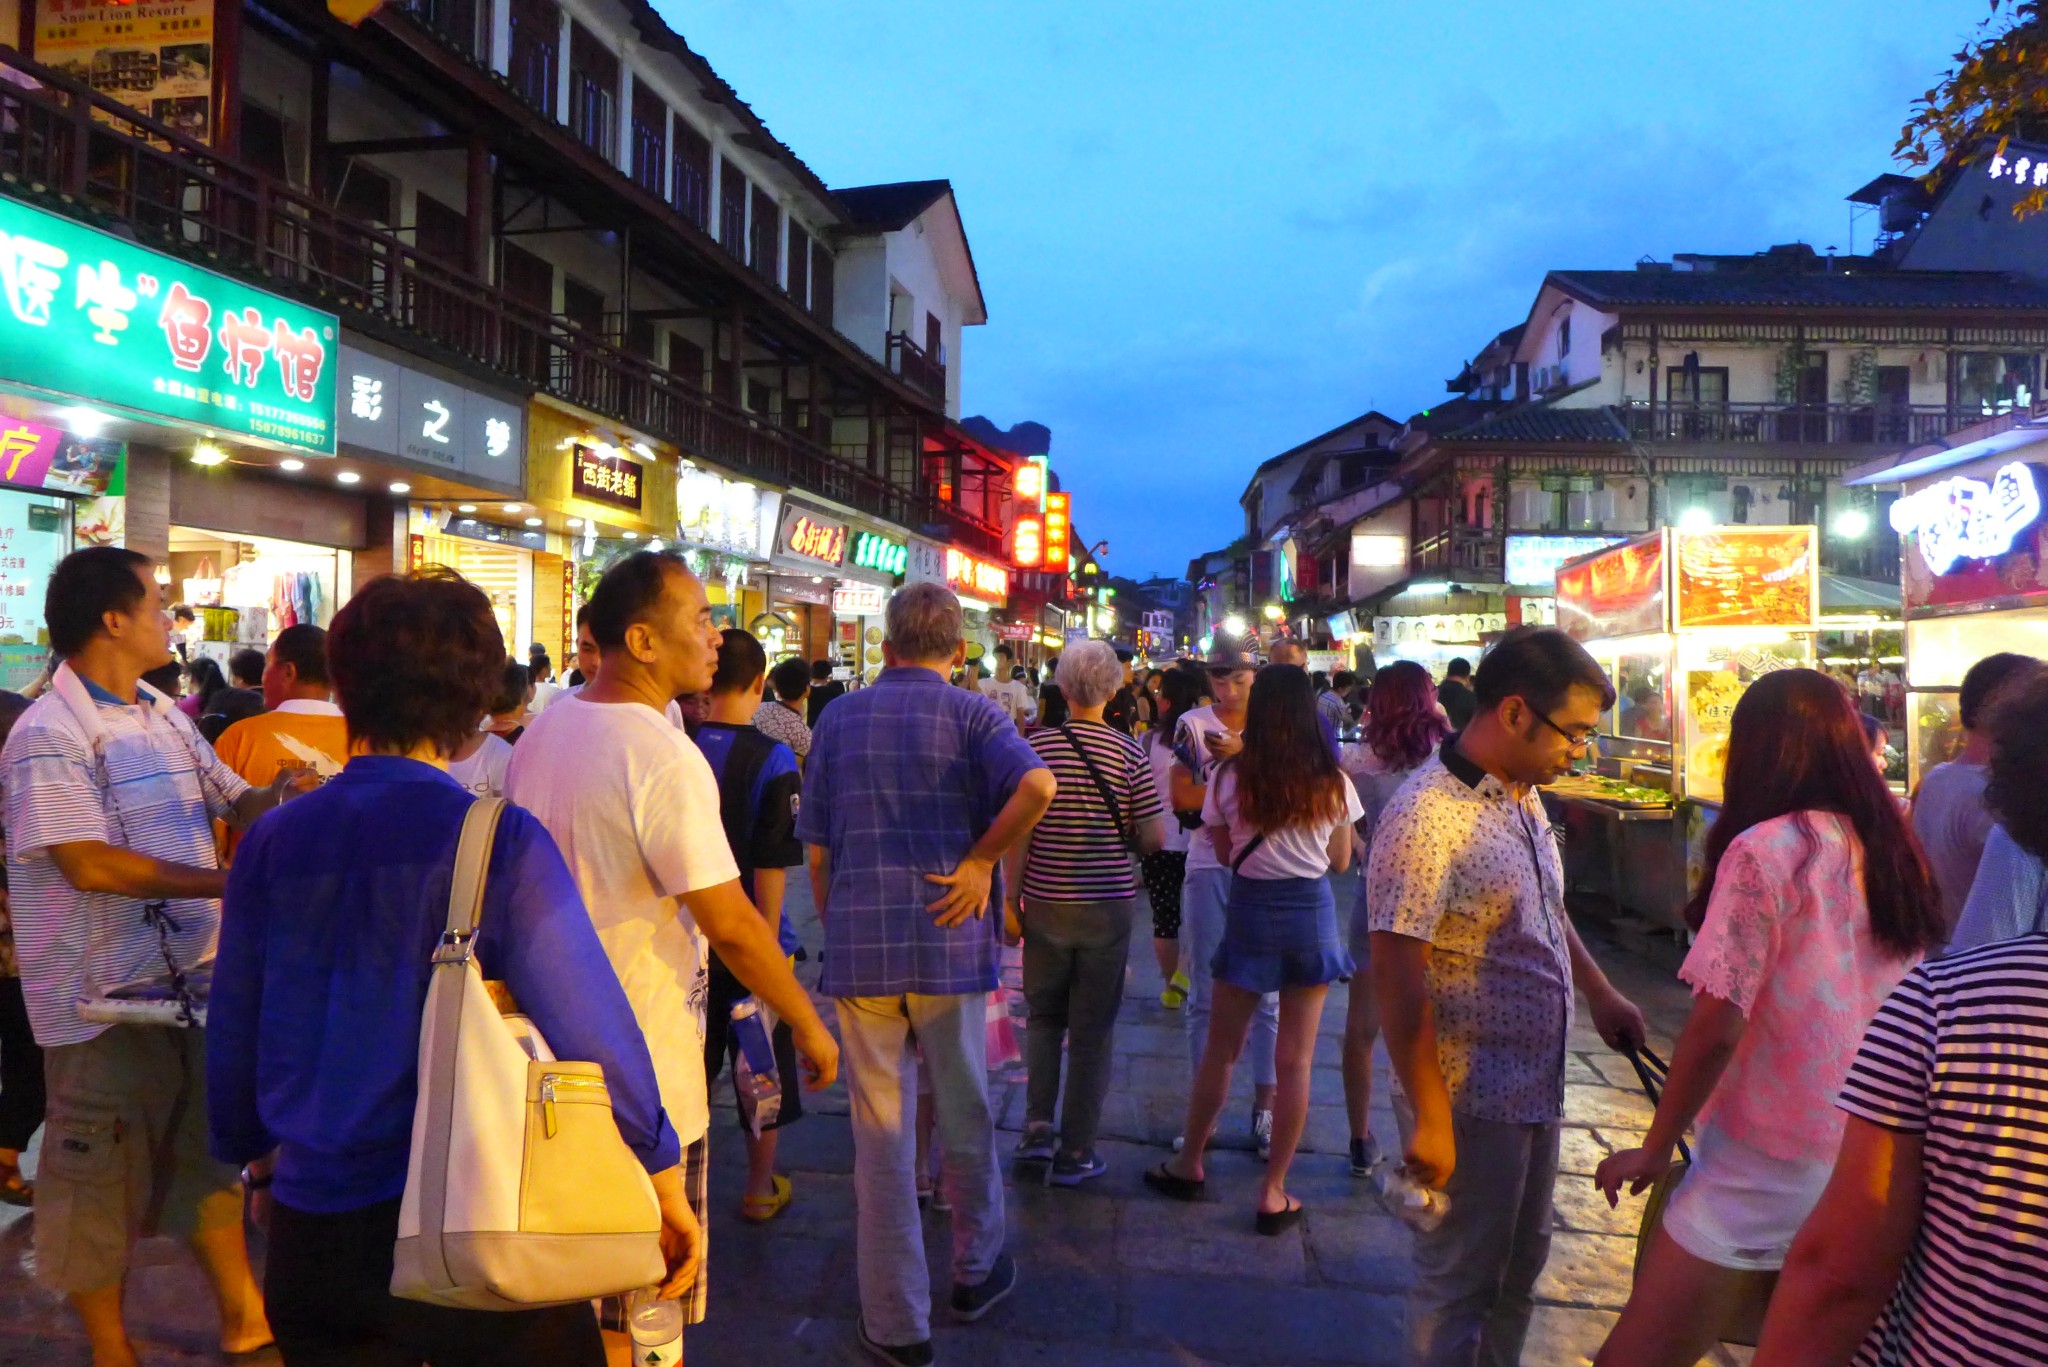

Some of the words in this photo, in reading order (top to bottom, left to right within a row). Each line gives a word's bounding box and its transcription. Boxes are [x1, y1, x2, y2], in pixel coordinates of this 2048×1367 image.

[137, 5, 186, 18] Resort
[351, 374, 511, 457] 彩之梦
